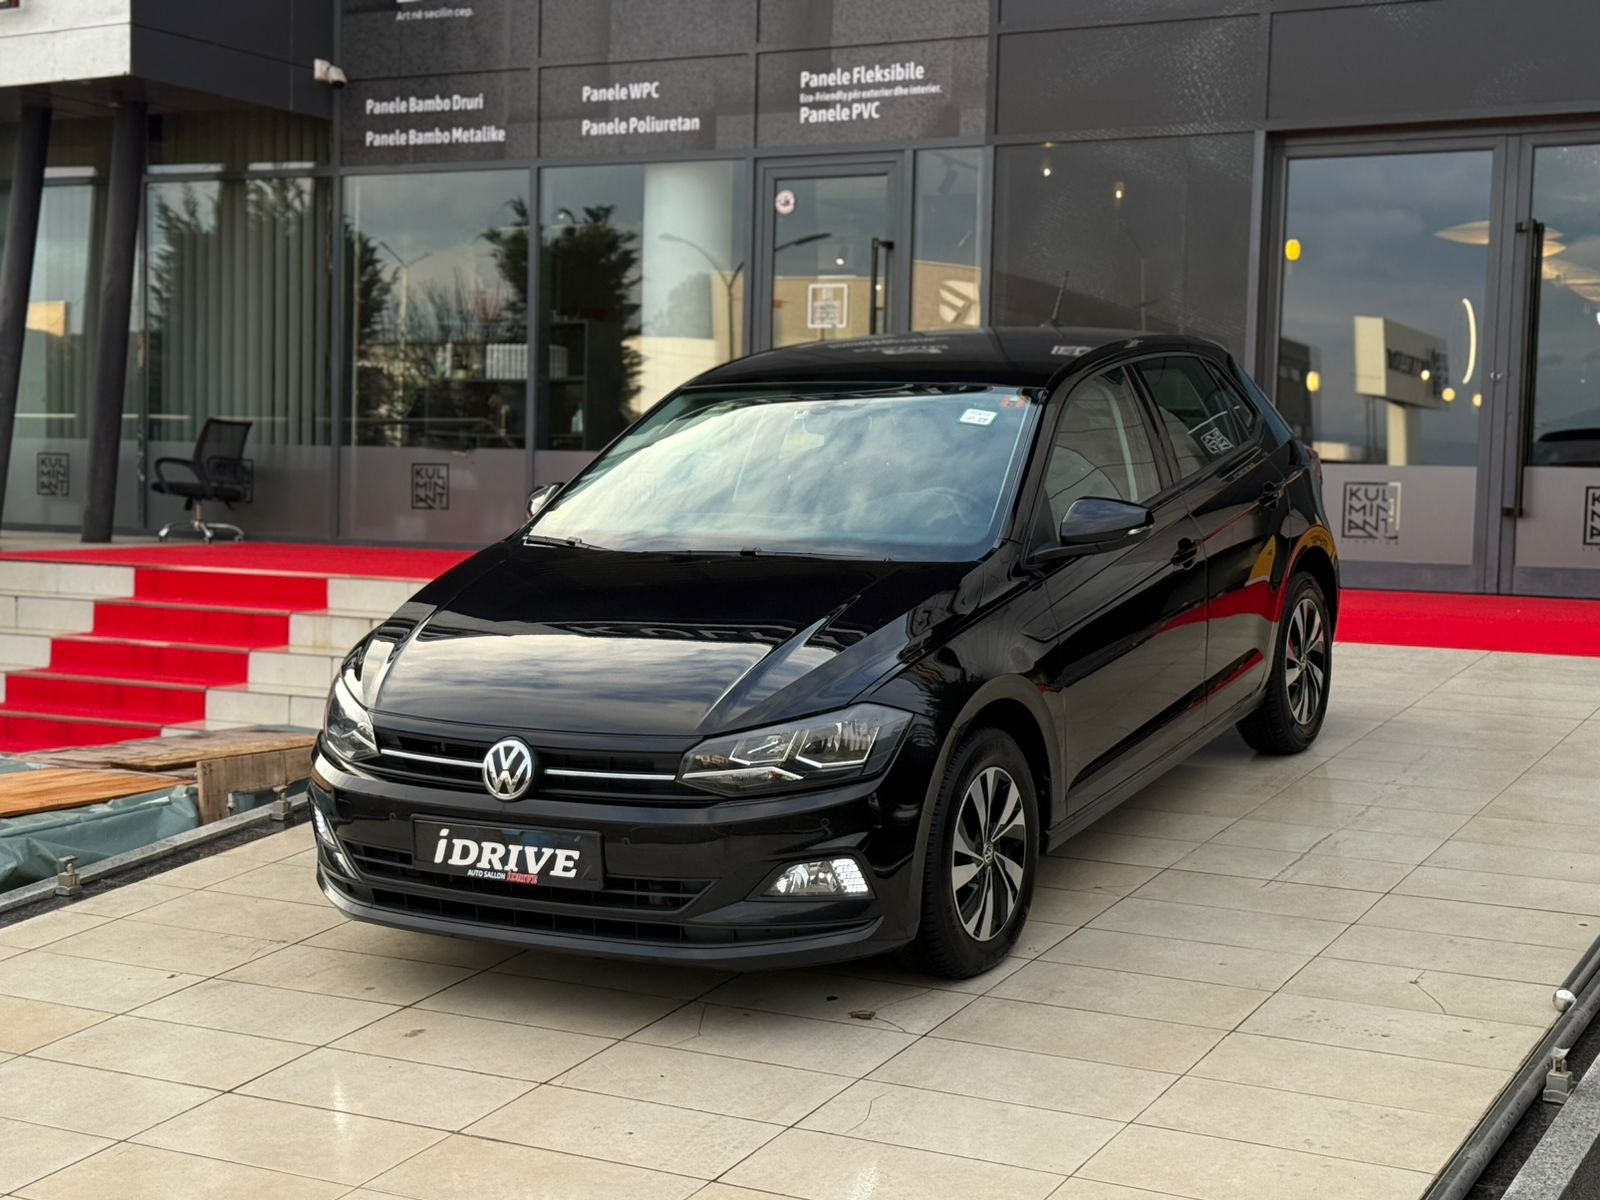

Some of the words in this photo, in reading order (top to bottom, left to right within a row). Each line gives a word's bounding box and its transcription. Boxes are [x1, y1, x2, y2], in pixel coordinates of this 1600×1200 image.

[800, 67, 851, 88] Panele
[852, 61, 925, 84] Fleksibile
[582, 83, 628, 102] Panele
[628, 81, 660, 99] WPC
[365, 97, 407, 115] Panele
[408, 94, 451, 112] Bambo
[452, 93, 484, 110] Druri
[800, 103, 850, 124] Panele
[852, 101, 880, 120] PVC
[365, 129, 407, 147] Panele
[408, 126, 451, 145] Bambo
[452, 125, 506, 143] Metalike
[581, 117, 627, 136] Panele
[628, 115, 700, 133] Poliuretan
[484, 738, 532, 800] VW
[433, 828, 581, 878] iDRIVE
[467, 869, 483, 877] AUTO
[483, 870, 506, 880] SALLON
